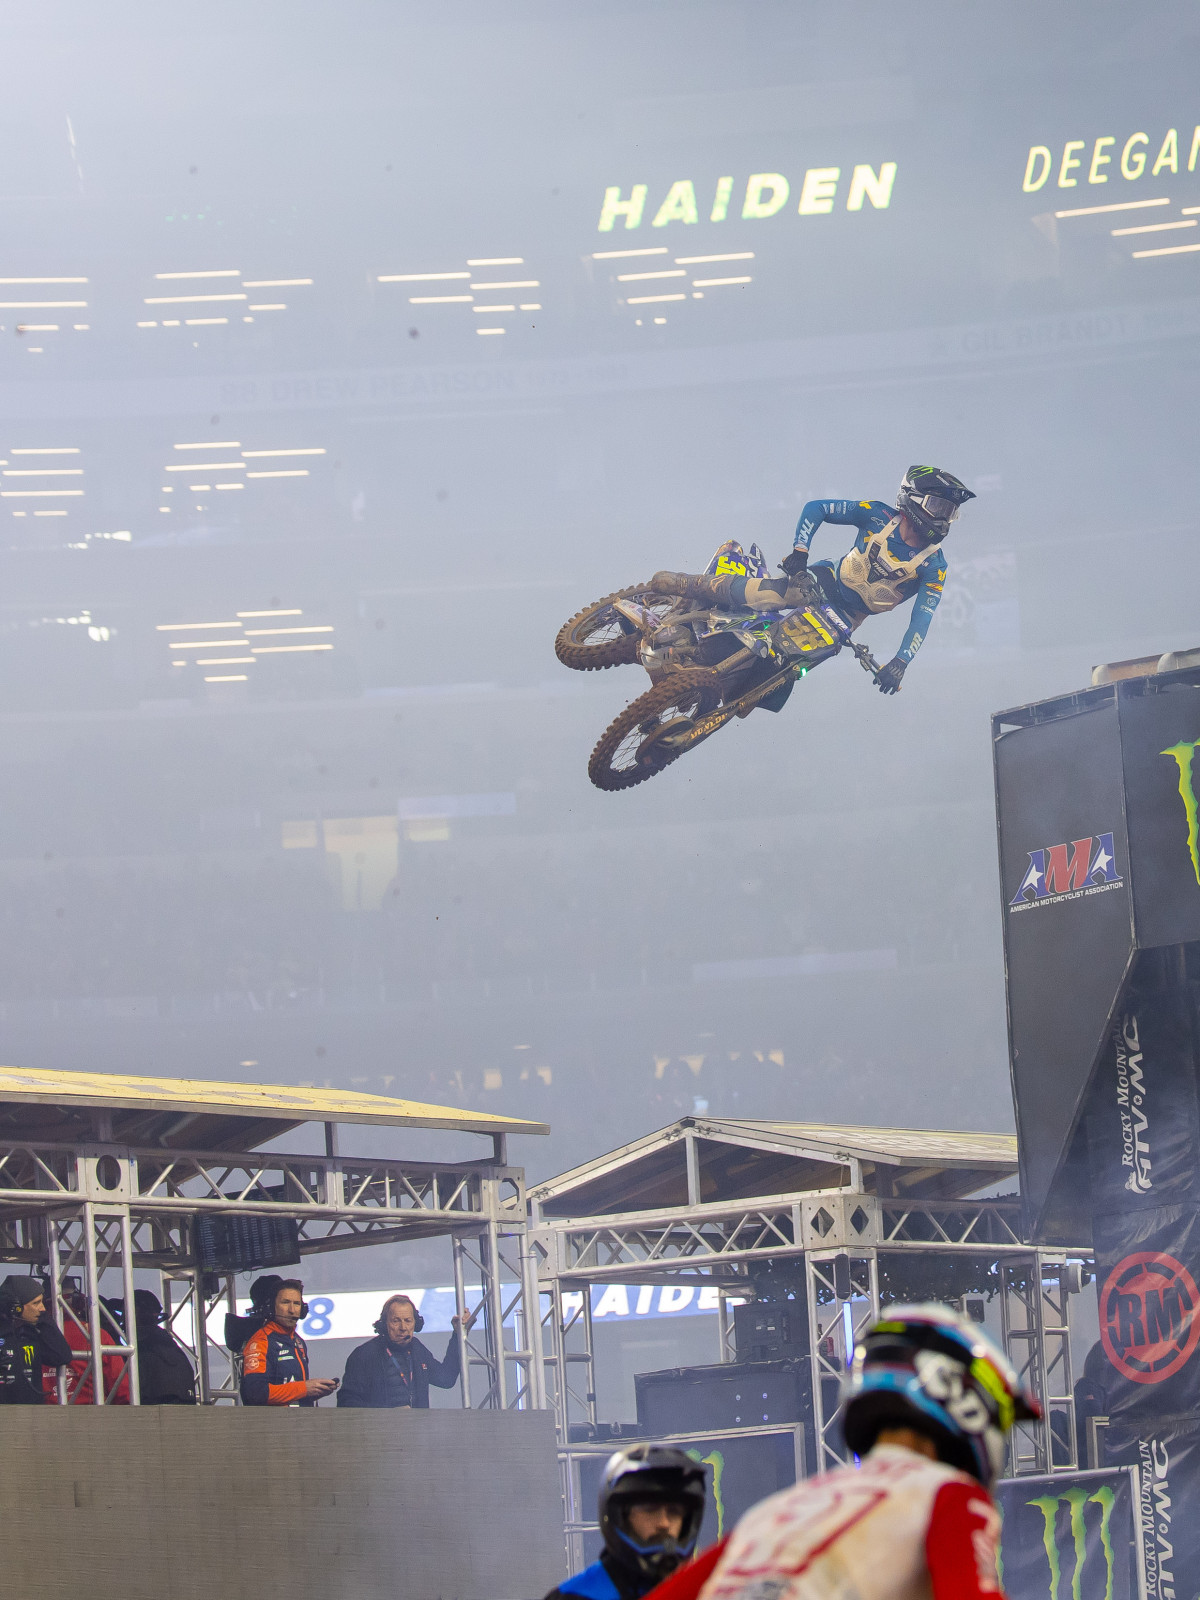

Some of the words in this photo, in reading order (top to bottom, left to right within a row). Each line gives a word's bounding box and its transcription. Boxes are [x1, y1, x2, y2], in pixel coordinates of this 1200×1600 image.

[597, 161, 898, 232] HAIDEN
[271, 374, 359, 401] DREW
[370, 368, 517, 398] PEARSON
[1008, 832, 1124, 905] AMA
[1010, 901, 1041, 914] AMERICAN
[1040, 891, 1084, 907] MOTORCYCLIST
[1085, 881, 1124, 896] ASSOCIATION
[1120, 1110, 1135, 1168] ROCKY
[562, 1284, 746, 1319] HAIDE
[1117, 1282, 1185, 1349] RM
[1138, 1440, 1156, 1536] MOUNTAIN
[1143, 1539, 1158, 1598] ROCKY
